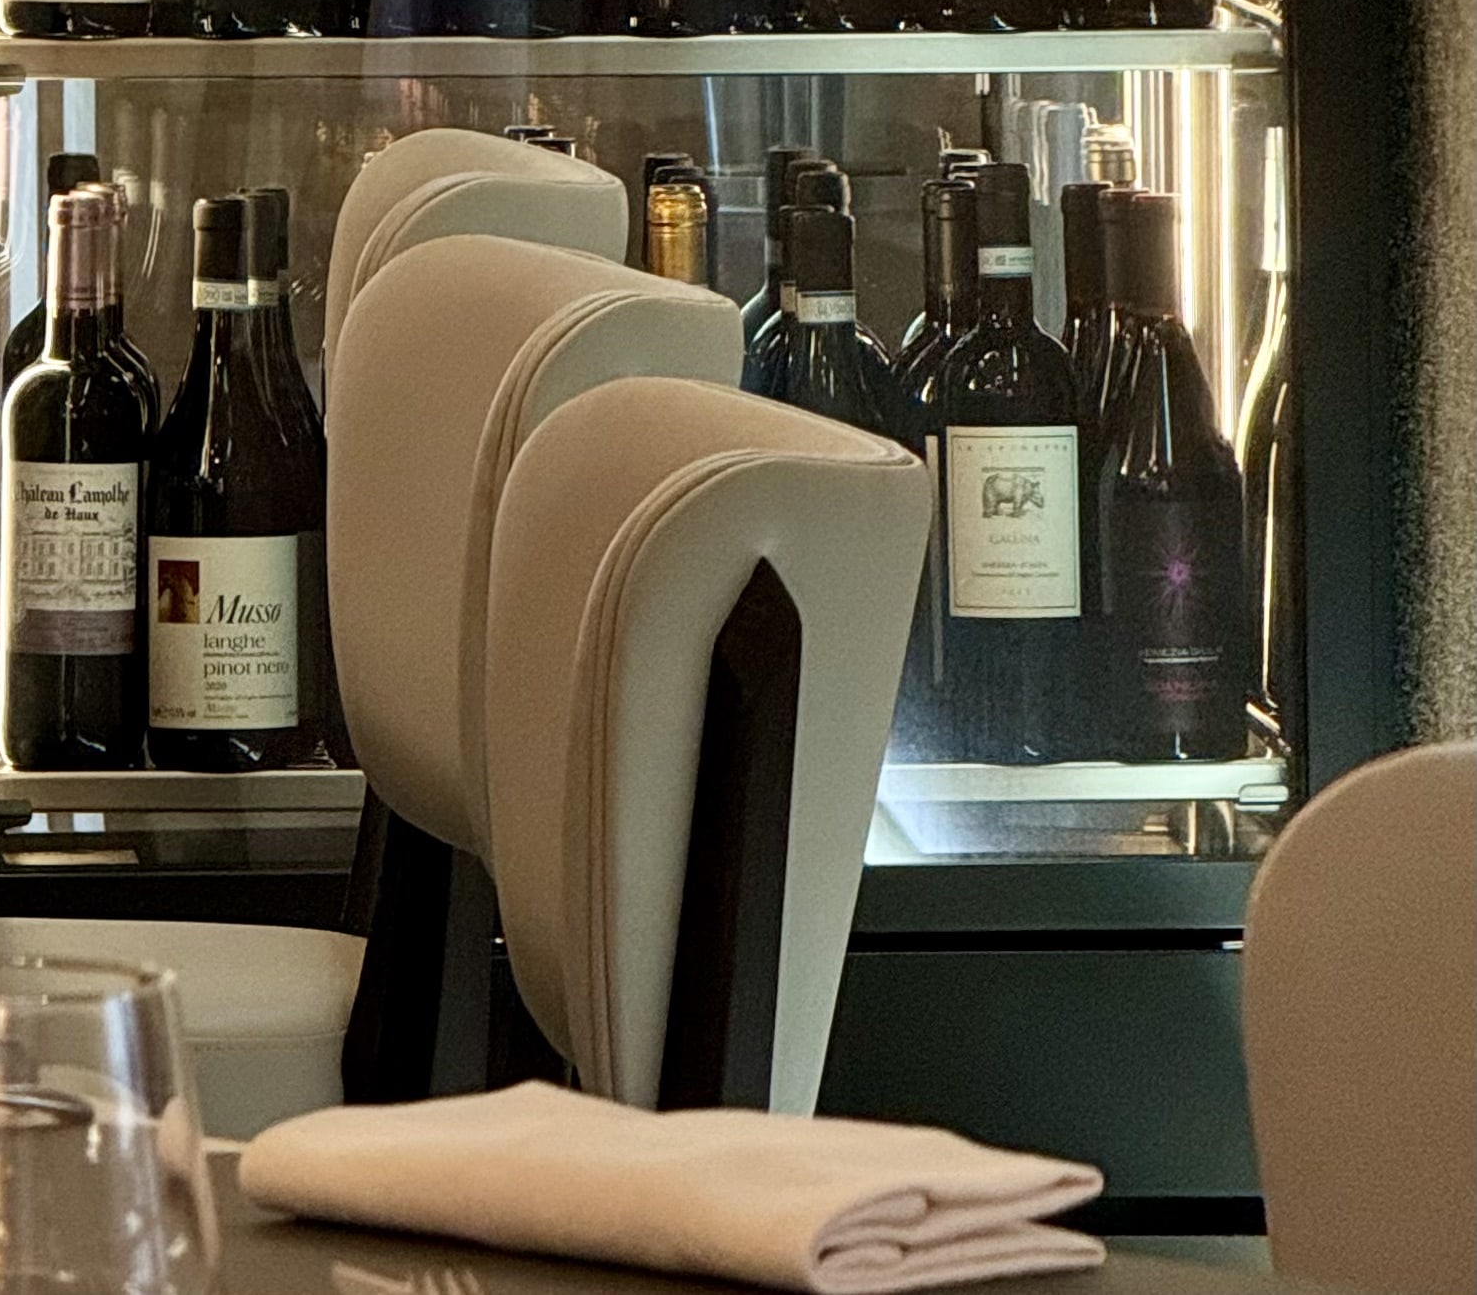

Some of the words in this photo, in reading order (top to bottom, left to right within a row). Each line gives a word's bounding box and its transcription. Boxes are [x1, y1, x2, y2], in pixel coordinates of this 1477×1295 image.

[44, 506, 59, 520] de
[204, 594, 283, 625] Musso
[203, 632, 266, 653] langhe
[203, 661, 251, 680] pinot
